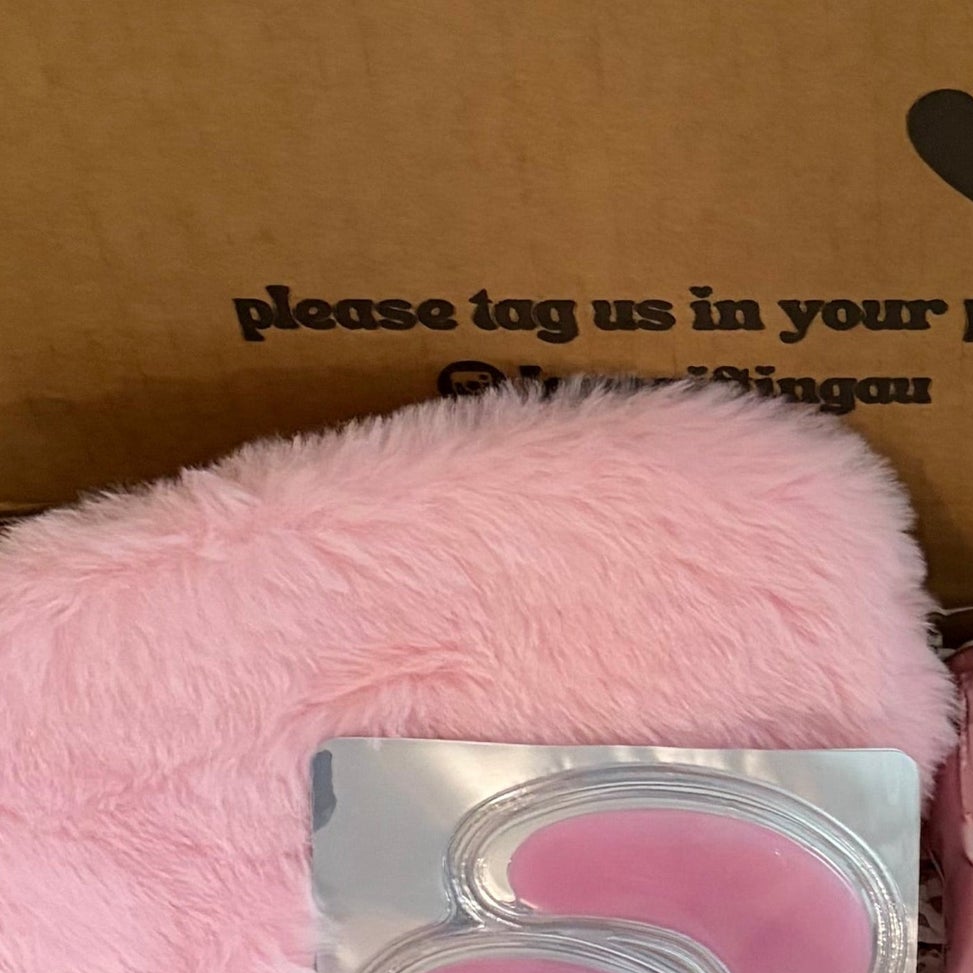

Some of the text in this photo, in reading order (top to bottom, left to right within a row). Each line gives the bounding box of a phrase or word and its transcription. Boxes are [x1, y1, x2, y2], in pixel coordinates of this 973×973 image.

[232, 285, 458, 341] please
[469, 289, 580, 343] tag
[592, 298, 677, 332] us
[688, 285, 766, 332] in
[776, 297, 948, 344] your
